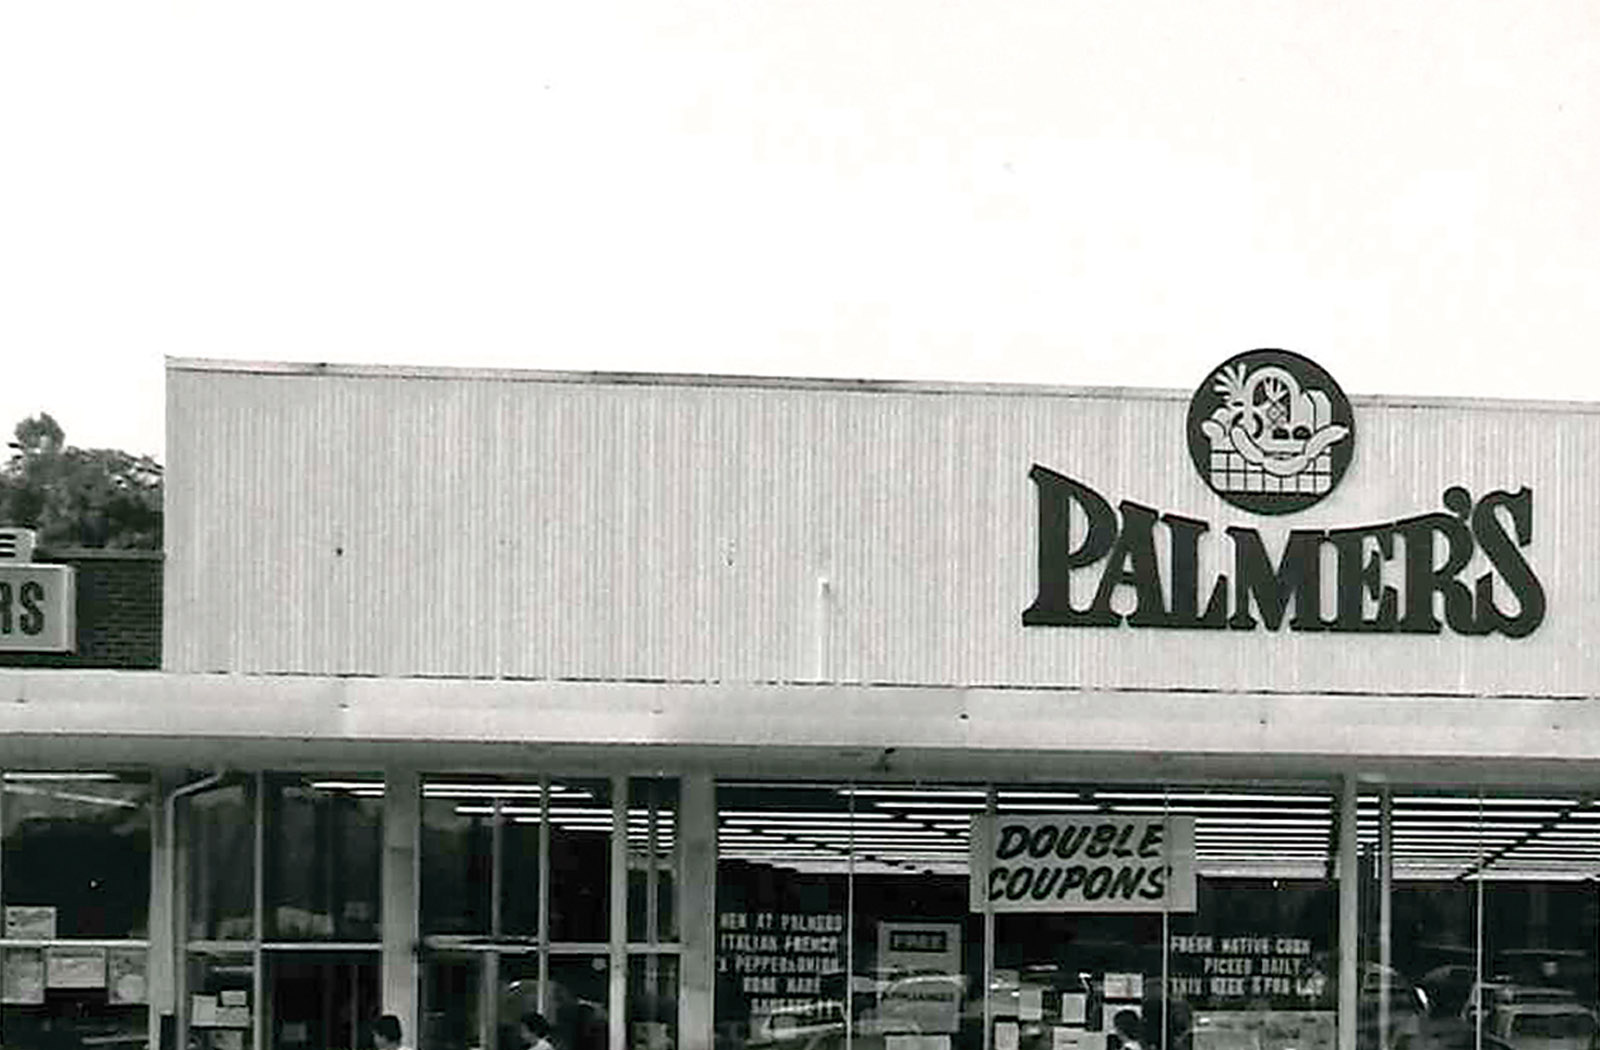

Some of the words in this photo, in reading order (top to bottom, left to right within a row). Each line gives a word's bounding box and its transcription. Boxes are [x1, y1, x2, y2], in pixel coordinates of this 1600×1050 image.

[1022, 464, 1546, 639] PALMER'S
[996, 824, 1164, 860] DOUBLE
[989, 866, 1173, 901] COUPONS
[720, 912, 747, 930] NEW
[756, 912, 773, 930] AT
[720, 933, 777, 952] ITALIAN
[784, 934, 838, 953] FRENCH
[1170, 935, 1213, 954] FRESH
[1218, 937, 1270, 955] NATIVE
[1275, 938, 1311, 955] CORN
[1204, 957, 1252, 975] PICKED
[1261, 957, 1300, 975] DAILY
[1169, 976, 1202, 996] THIS
[1210, 976, 1245, 996] WEEK
